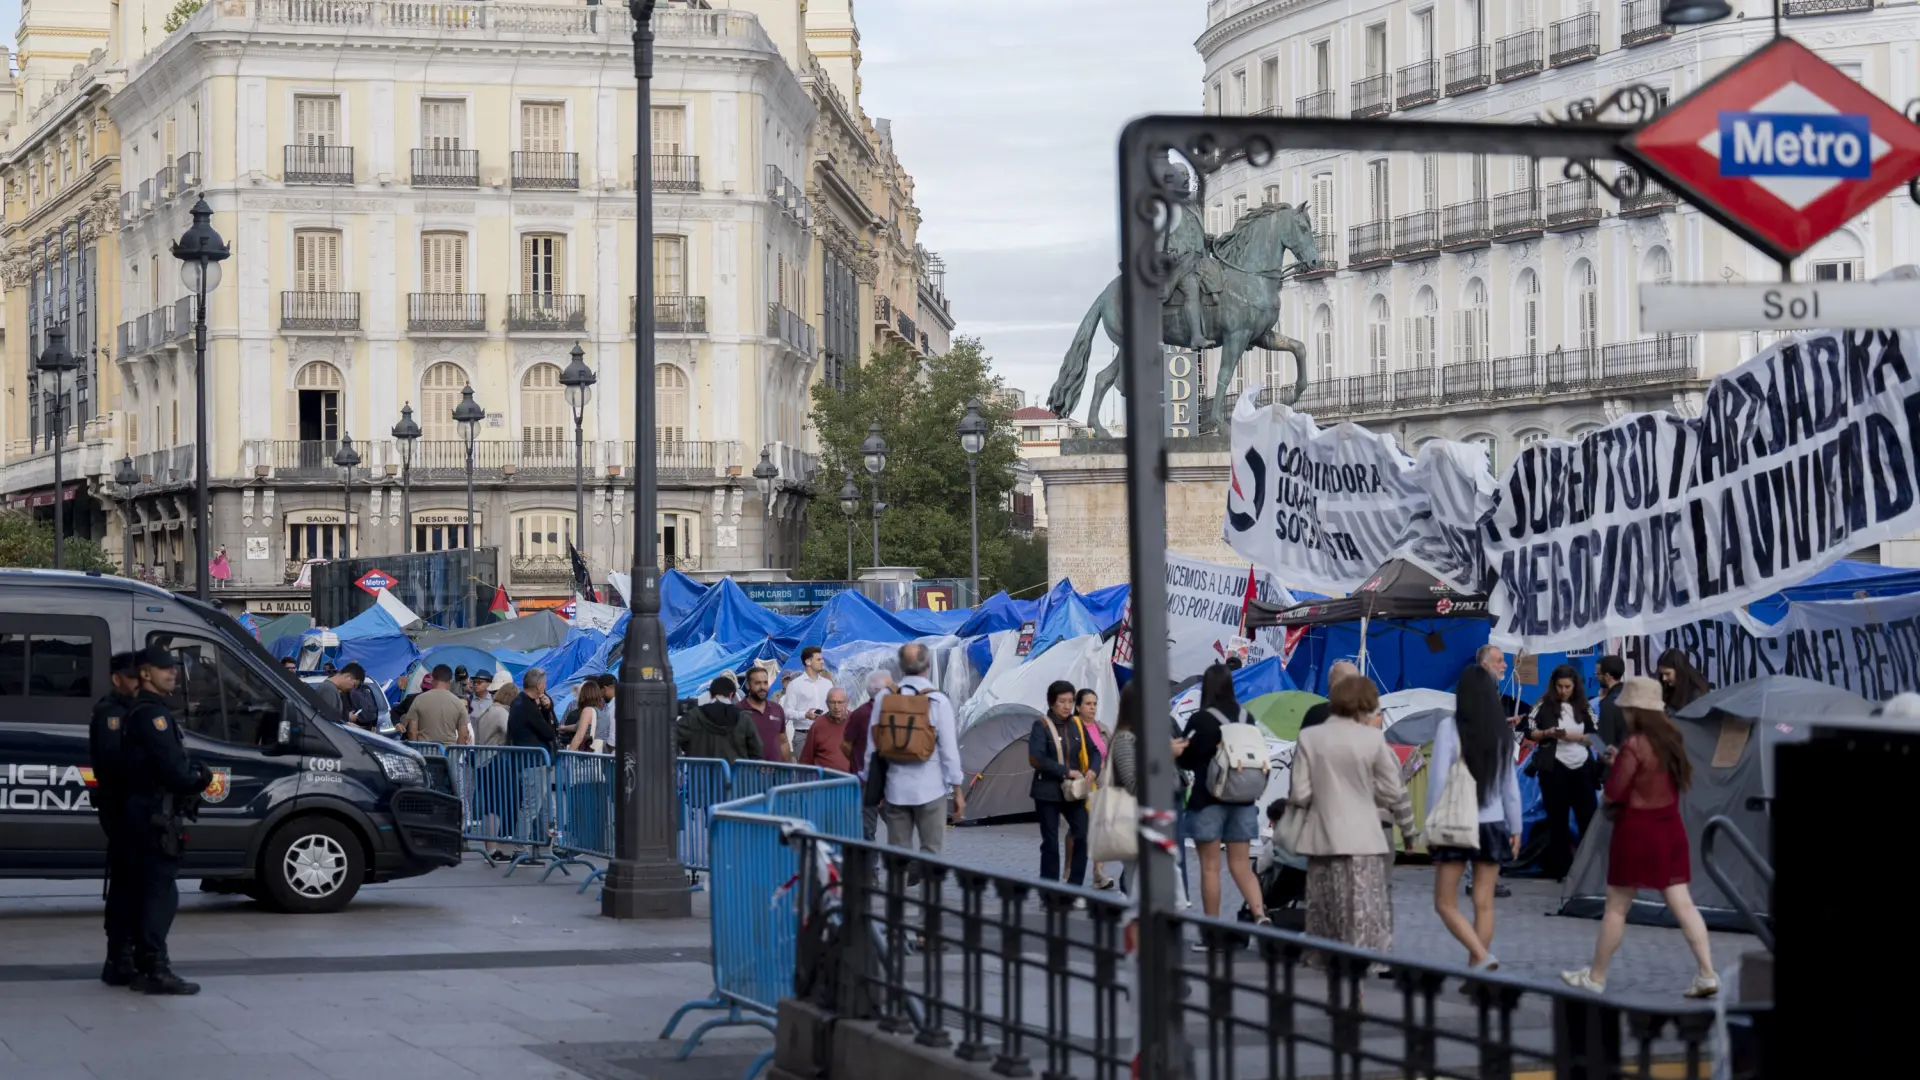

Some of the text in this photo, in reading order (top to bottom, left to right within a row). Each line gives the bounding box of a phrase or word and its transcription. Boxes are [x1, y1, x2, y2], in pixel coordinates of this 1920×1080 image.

[1732, 120, 1862, 168] Metro
[1762, 289, 1821, 320] Sol
[306, 515, 340, 523] SALÓN
[1649, 509, 1691, 615] DE
[1689, 486, 1745, 600] LA
[365, 578, 386, 586] Metro
[1207, 572, 1216, 592] A
[1217, 574, 1231, 597] LA
[750, 590, 792, 598] SIM CARDS
[260, 602, 273, 611] LA
[1186, 596, 1210, 619] POR
[1208, 600, 1223, 623] LA
[0, 763, 86, 786] ICIA
[317, 758, 341, 772] 091
[0, 788, 99, 811] IONA
